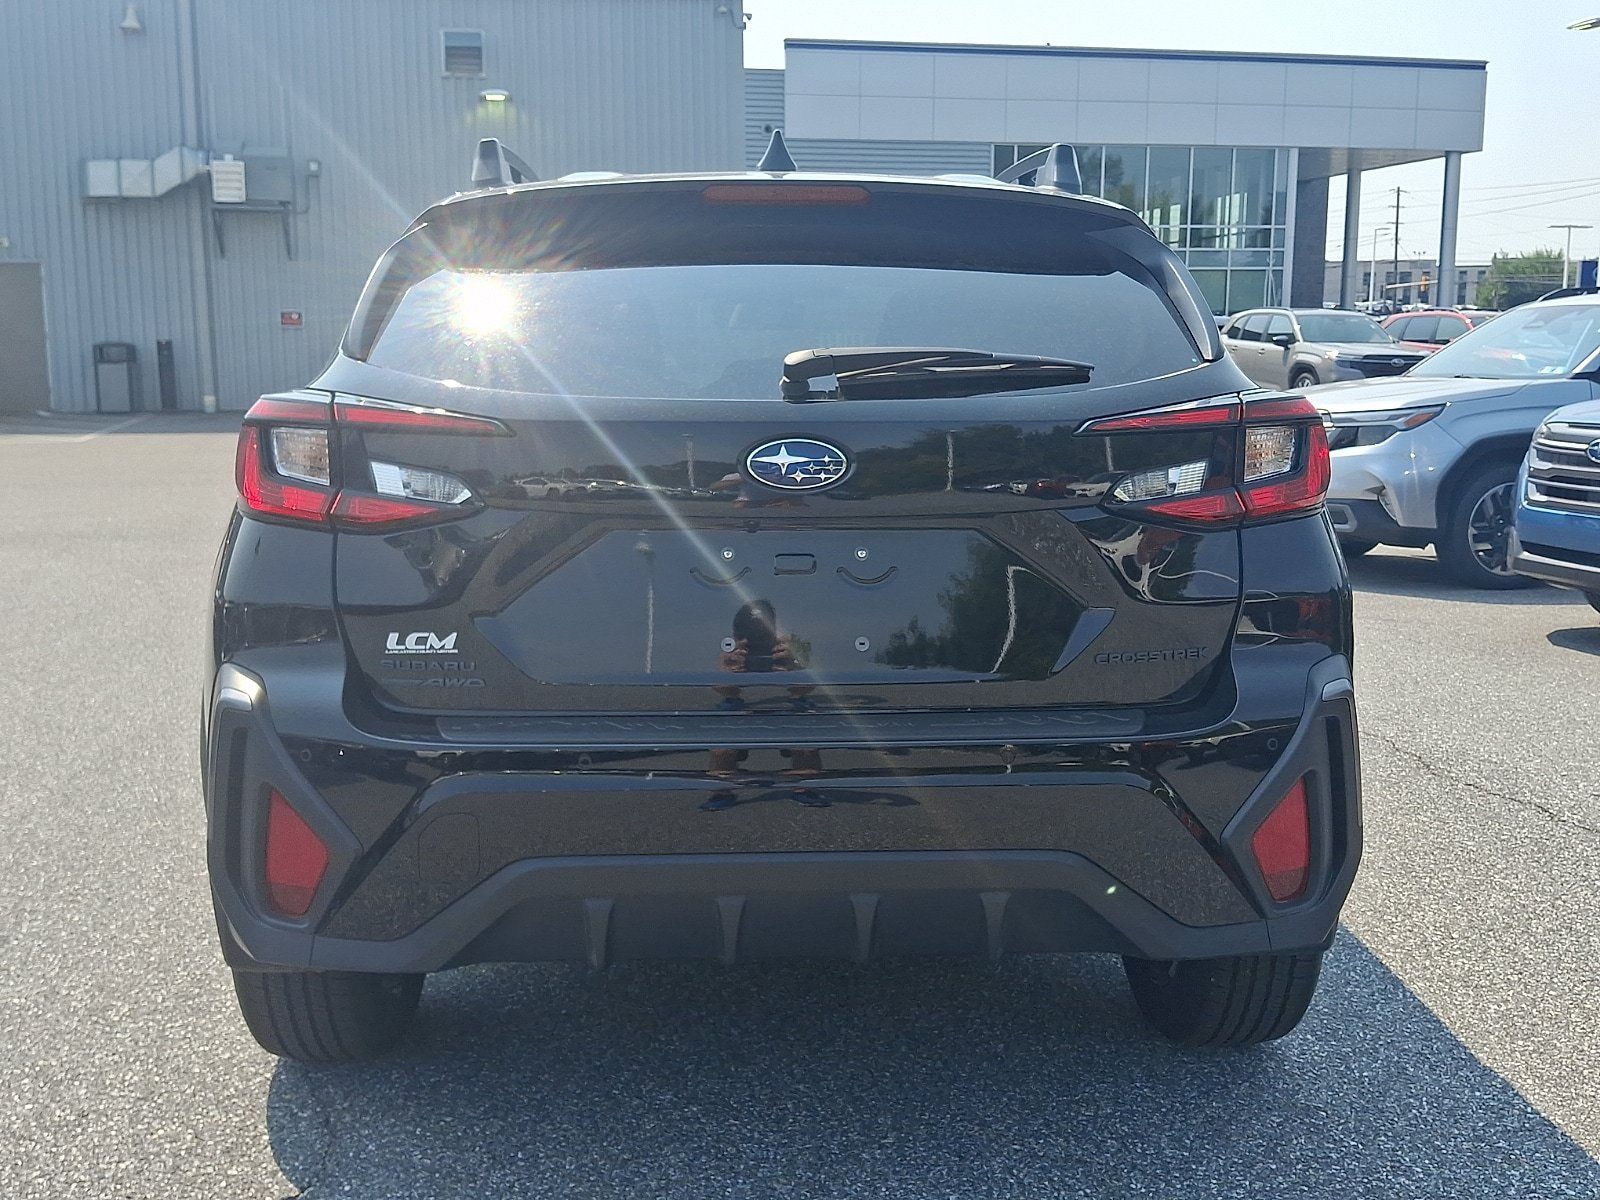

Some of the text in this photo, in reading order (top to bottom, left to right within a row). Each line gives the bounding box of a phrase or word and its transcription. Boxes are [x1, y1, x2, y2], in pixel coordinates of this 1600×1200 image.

[386, 632, 458, 649] LCM
[1094, 647, 1208, 665] CROSSTREK
[381, 660, 477, 671] SUBARU
[419, 677, 486, 687] AWD
